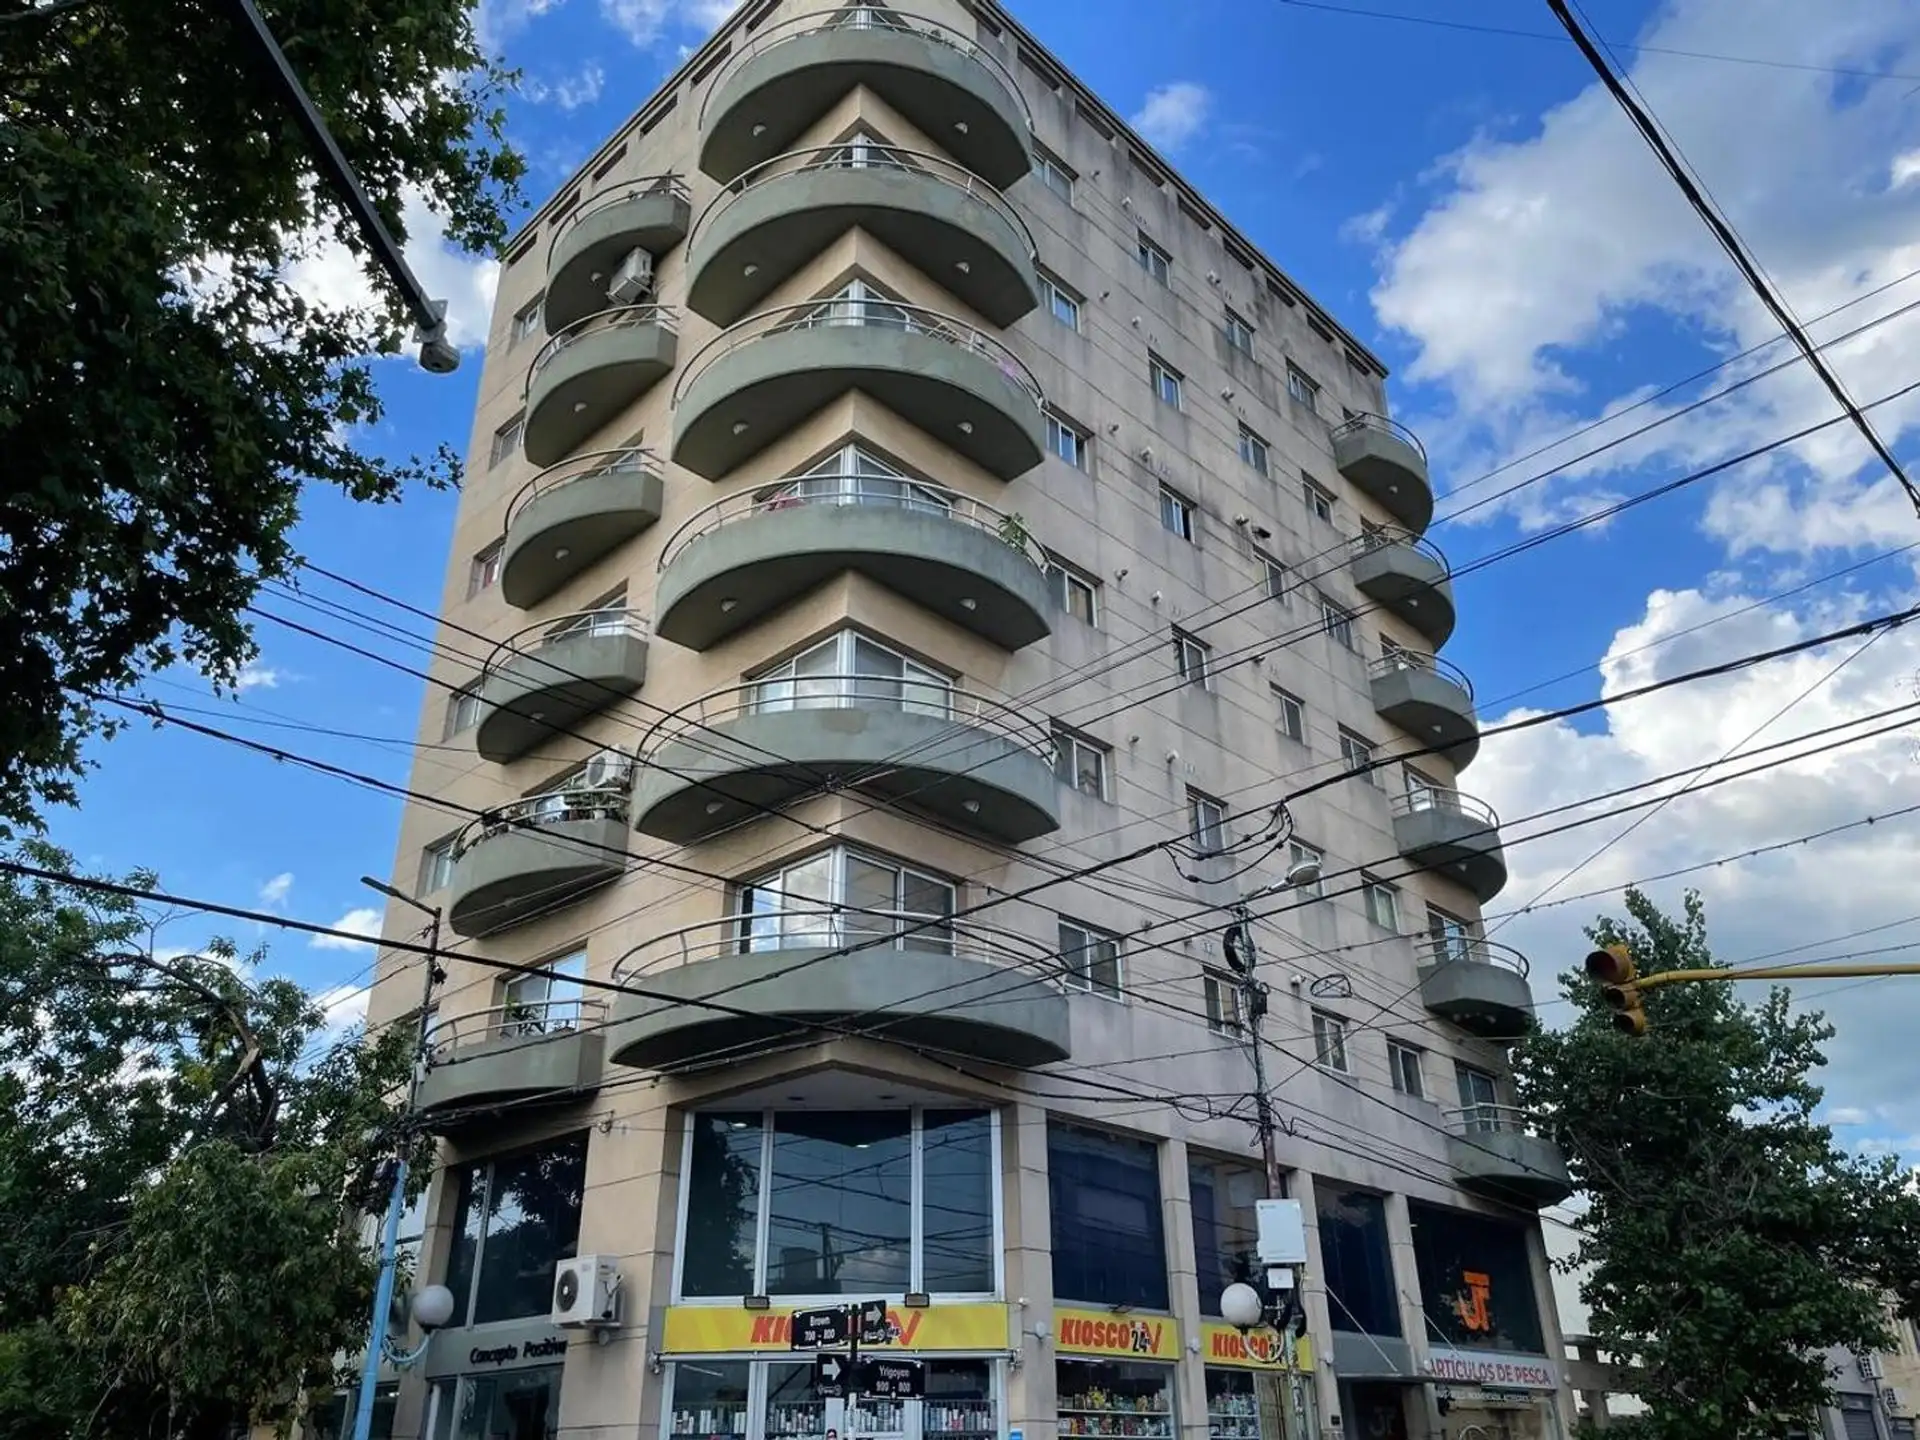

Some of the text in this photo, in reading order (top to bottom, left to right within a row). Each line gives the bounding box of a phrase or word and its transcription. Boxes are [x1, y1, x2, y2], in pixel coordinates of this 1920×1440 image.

[810, 1316, 831, 1327] Brown
[1060, 1318, 1130, 1349] KIOSCO
[469, 1344, 518, 1366] Concepto
[1496, 1363, 1513, 1382] DE
[1514, 1366, 1552, 1385] PESCA
